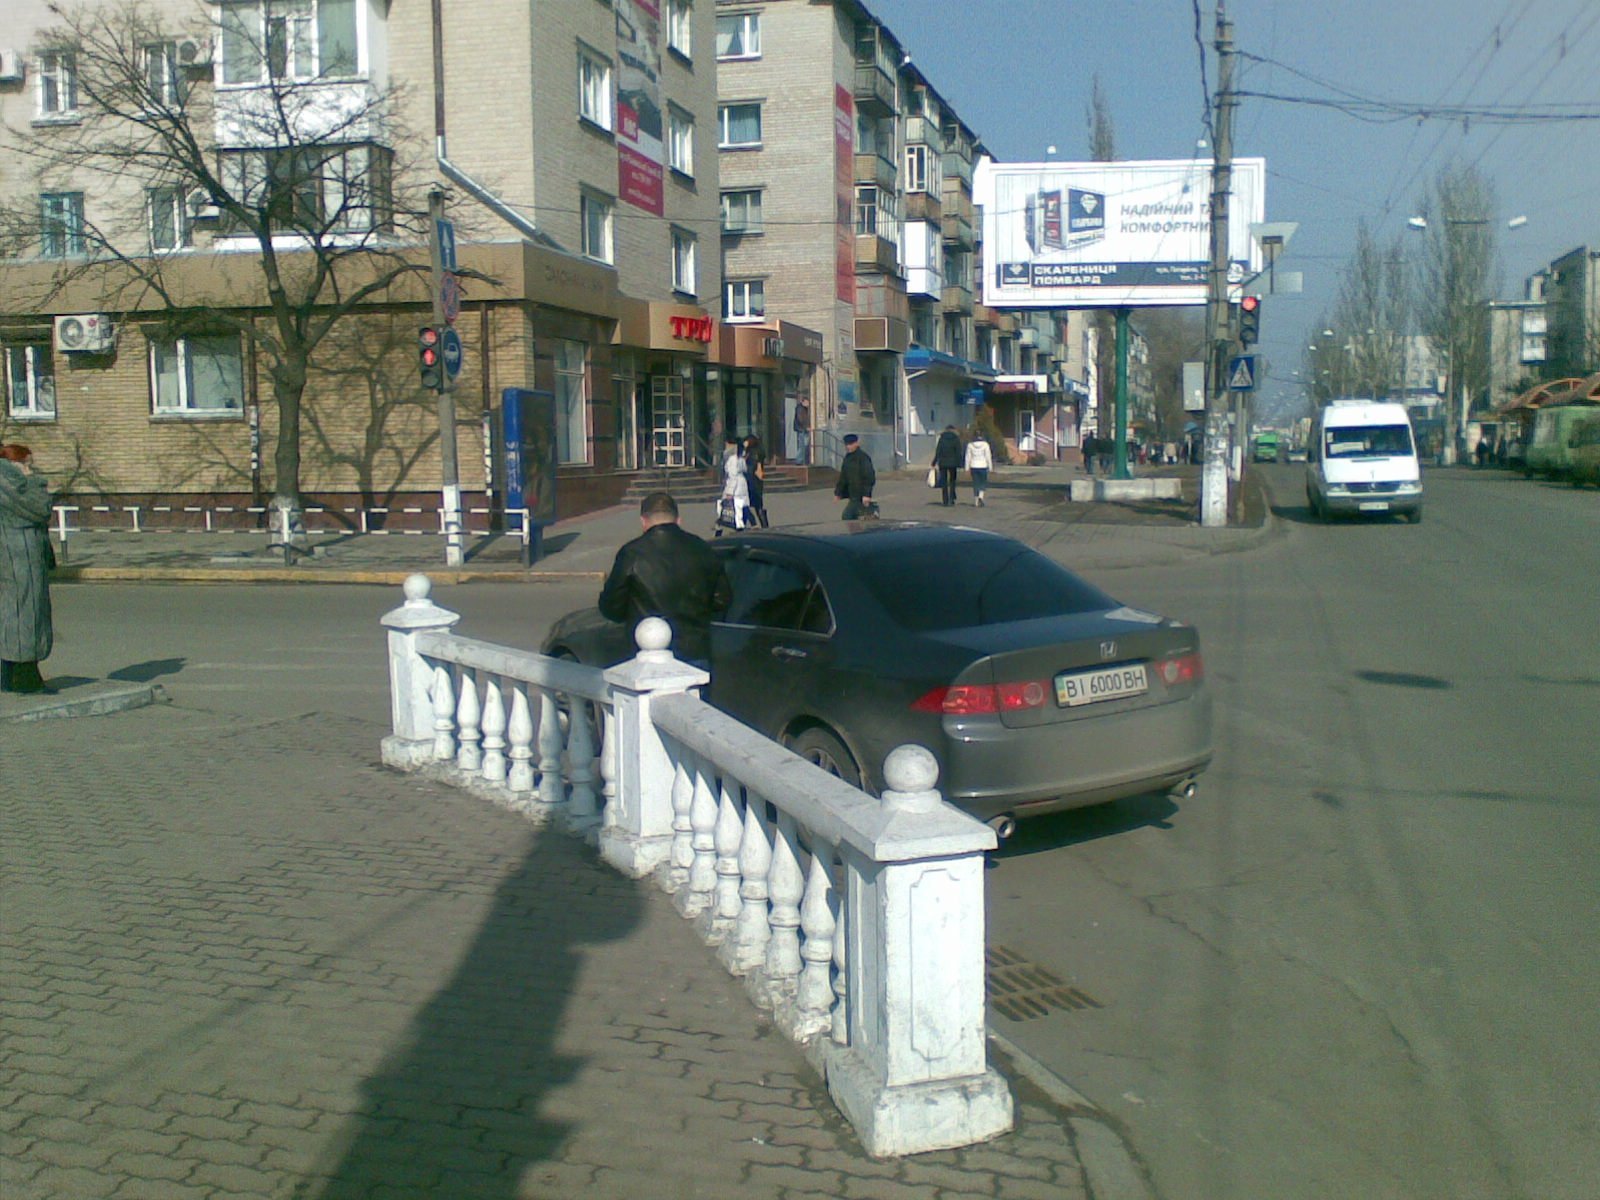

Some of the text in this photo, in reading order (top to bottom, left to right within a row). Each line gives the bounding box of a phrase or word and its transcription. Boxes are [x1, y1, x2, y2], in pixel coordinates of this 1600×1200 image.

[1120, 201, 1193, 217] НАДІЙНИЙ
[1120, 220, 1213, 233] КОМФОРТНИ
[1033, 264, 1117, 275] СКАРЕНИЦЯ
[1033, 275, 1101, 285] ЛОМБАРД
[1090, 674, 1122, 694] 6000
